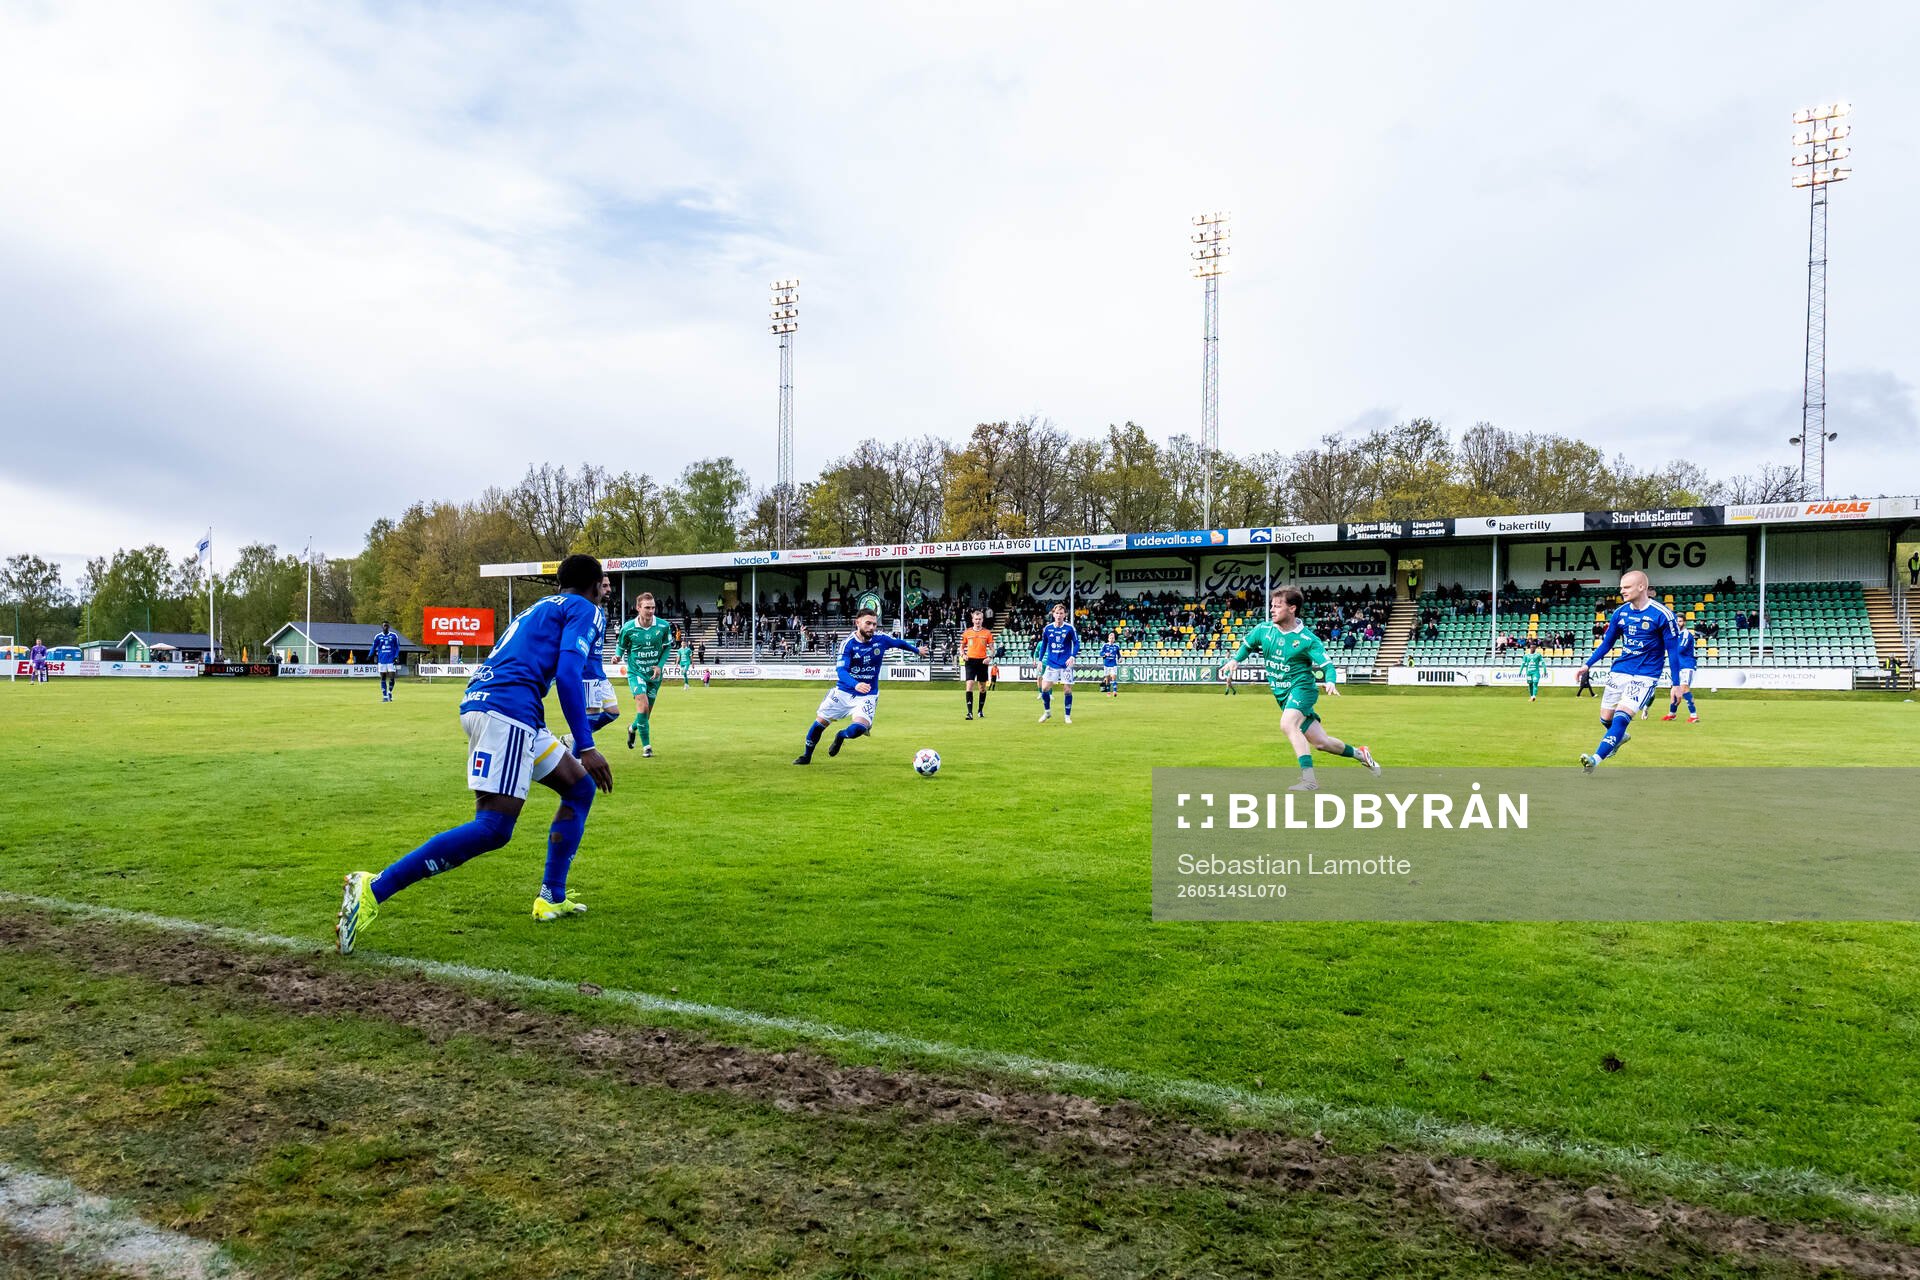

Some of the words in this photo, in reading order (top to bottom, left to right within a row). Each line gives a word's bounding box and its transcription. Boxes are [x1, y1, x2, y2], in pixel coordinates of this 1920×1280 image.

[1612, 510, 1693, 523] StorköksCenter
[1757, 506, 1799, 519] ARVID
[1347, 523, 1378, 537] Bröderna
[1380, 521, 1402, 535] Björks
[1499, 520, 1551, 531] bakertilly
[1134, 535, 1202, 547] uddevalla.se
[1275, 532, 1314, 542] BioTech
[919, 545, 935, 554] JTB
[945, 543, 960, 552] H.A
[962, 541, 986, 551] BYGG
[989, 541, 1004, 550] H.A
[1006, 540, 1031, 549] BYGG
[1034, 537, 1091, 552] LLENTAB
[865, 548, 880, 557] JTB
[892, 547, 908, 556] JTB
[1545, 546, 1600, 572] H.A
[1610, 542, 1707, 570] BYGG
[606, 559, 648, 569] Autoexperten
[734, 557, 769, 566] Nordea
[1032, 566, 1102, 595] Ford
[1205, 559, 1285, 592] Ford
[431, 616, 480, 630] renta
[638, 650, 659, 658] renta
[1266, 660, 1290, 672] renta
[891, 668, 916, 678] PUMA
[1133, 666, 1197, 681] SUPERETTAN
[1417, 671, 1455, 682] PUMA
